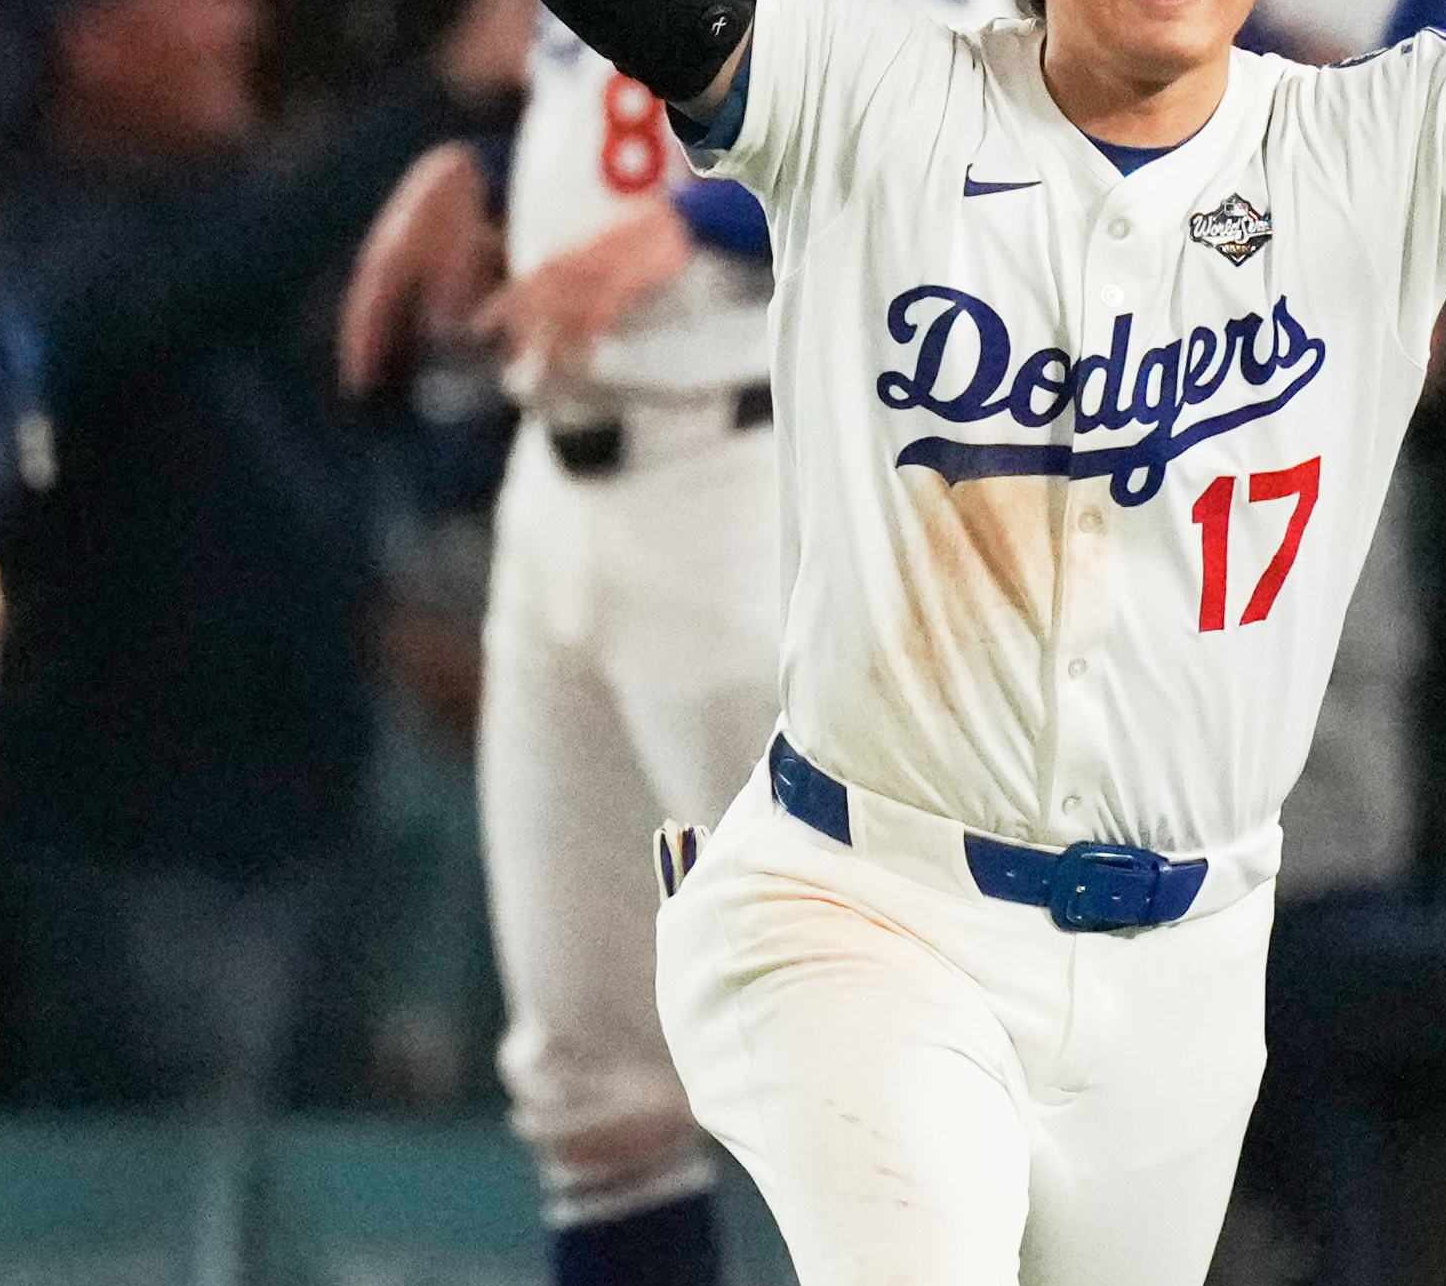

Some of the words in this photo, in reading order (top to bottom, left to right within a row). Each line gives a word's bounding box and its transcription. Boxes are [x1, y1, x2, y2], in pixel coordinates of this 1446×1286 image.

[1192, 215, 1242, 237] World
[875, 283, 1327, 509] Dodgers
[1191, 455, 1323, 634] 17
